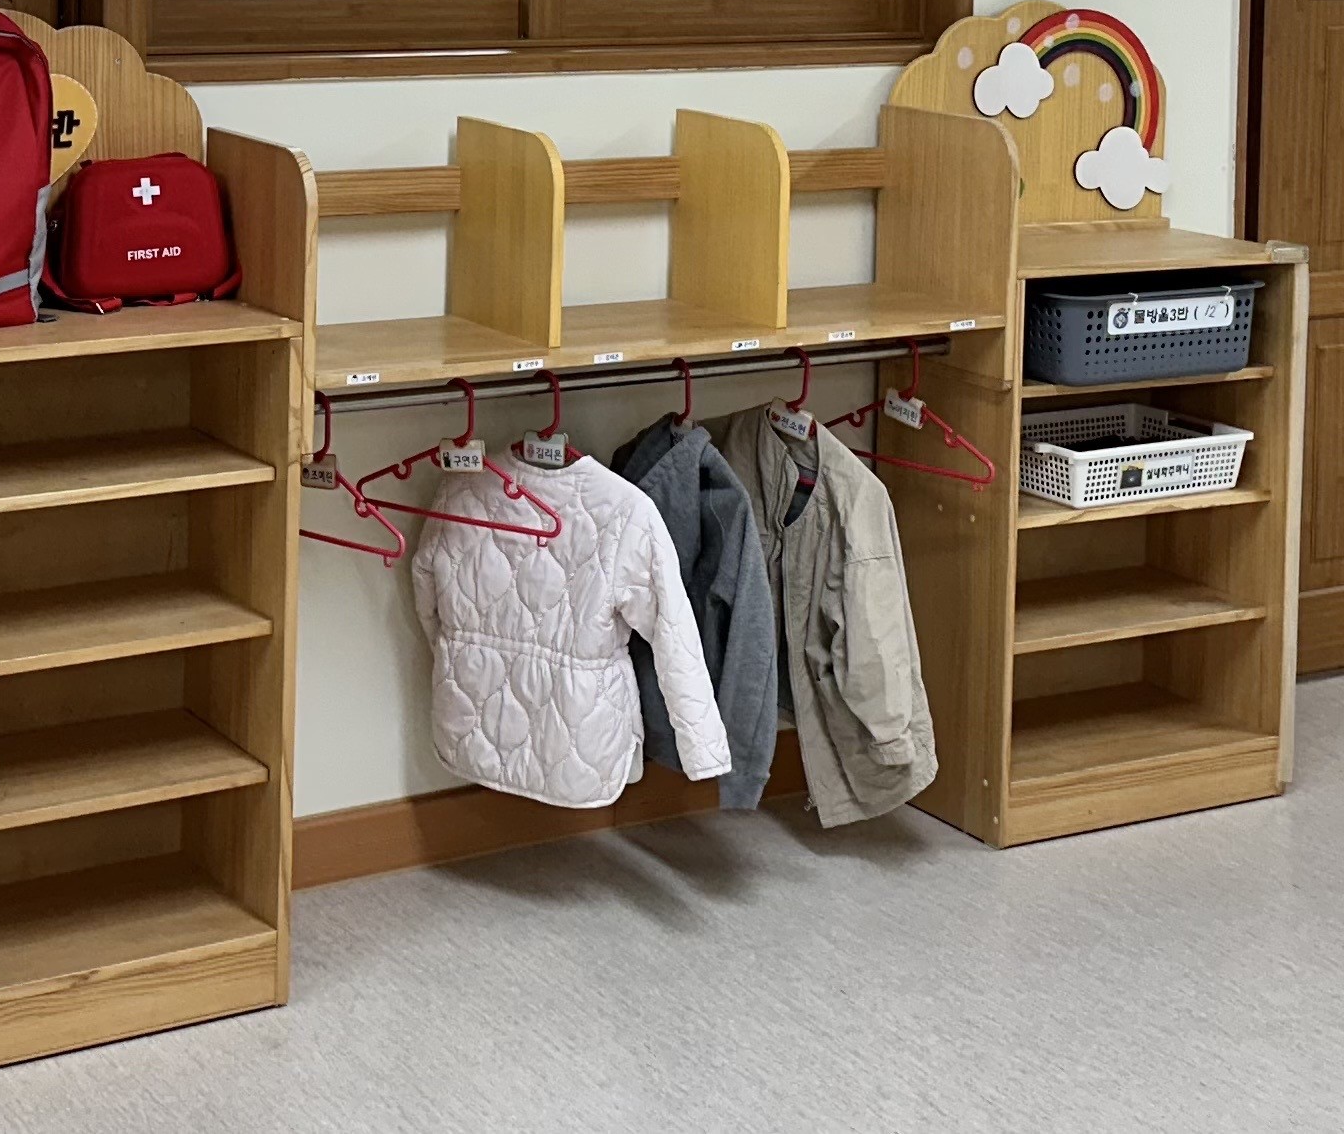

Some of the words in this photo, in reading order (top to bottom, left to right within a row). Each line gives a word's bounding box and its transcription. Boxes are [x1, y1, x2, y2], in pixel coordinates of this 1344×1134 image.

[127, 248, 159, 261] FIRST
[162, 246, 181, 257] AID
[1134, 307, 1189, 324] 물방울3반
[1146, 464, 1190, 480] 실내화주머니
